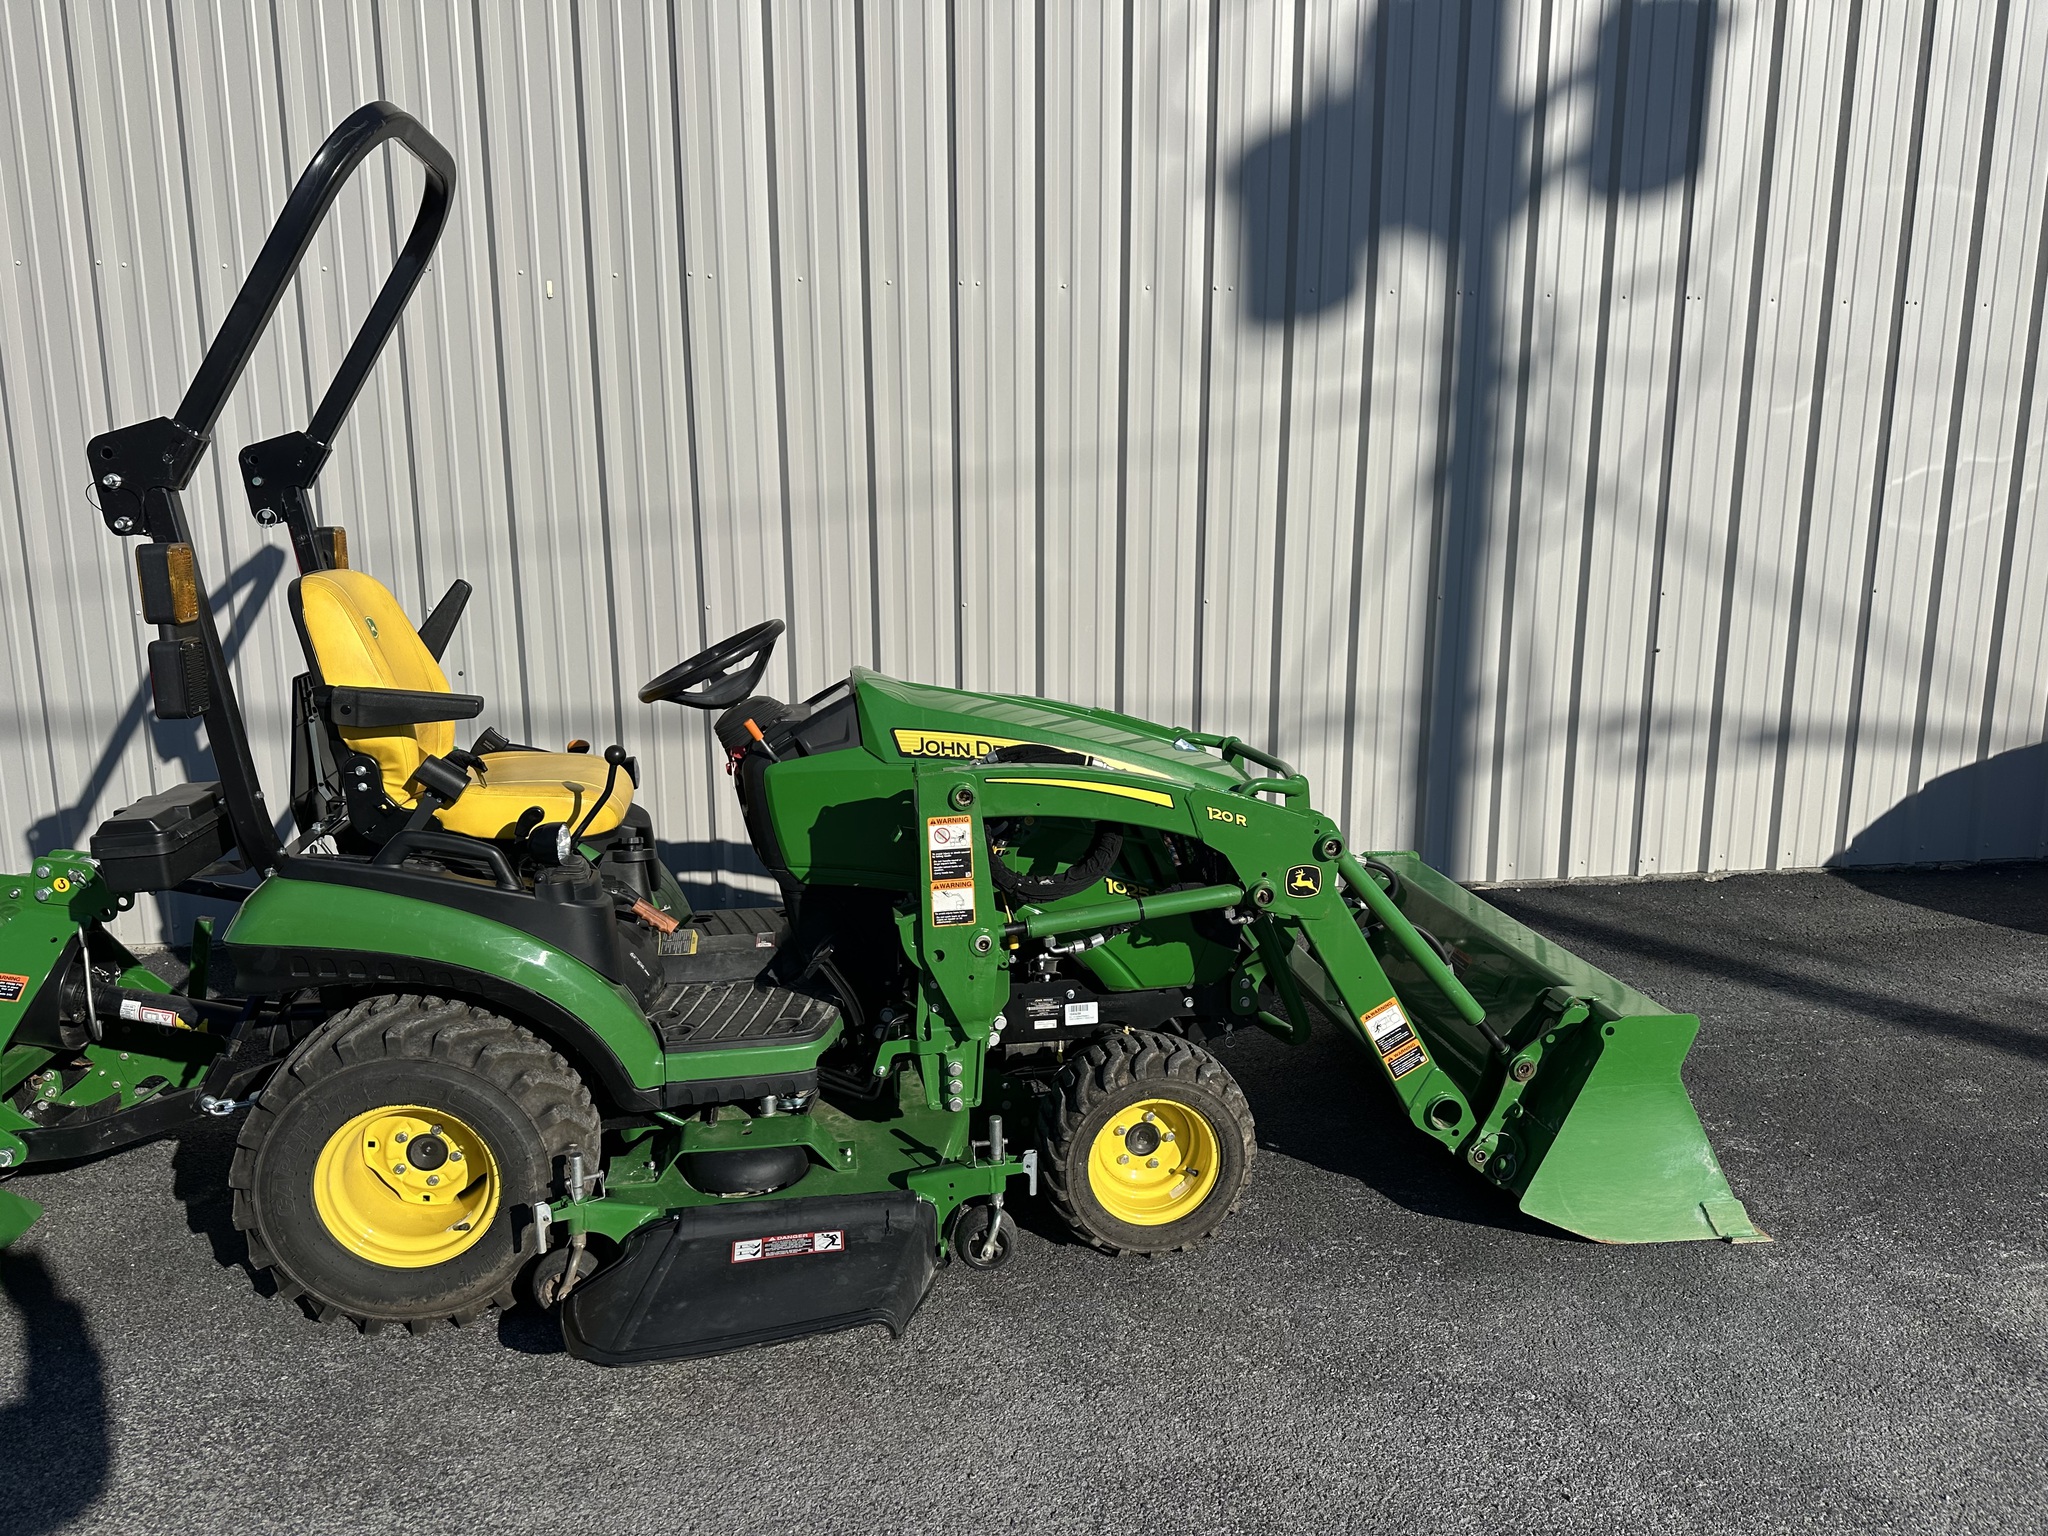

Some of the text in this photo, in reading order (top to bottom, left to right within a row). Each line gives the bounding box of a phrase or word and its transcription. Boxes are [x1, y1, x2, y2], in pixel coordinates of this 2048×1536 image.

[914, 737, 970, 756] JOHN
[936, 816, 969, 825] WARNING
[1206, 806, 1248, 827] 120 R
[939, 881, 972, 889] WARNING
[1105, 877, 1150, 897] 1025
[1370, 1001, 1393, 1016] WARNING
[1394, 1042, 1416, 1057] WARNING
[776, 1233, 809, 1241] DANGER
